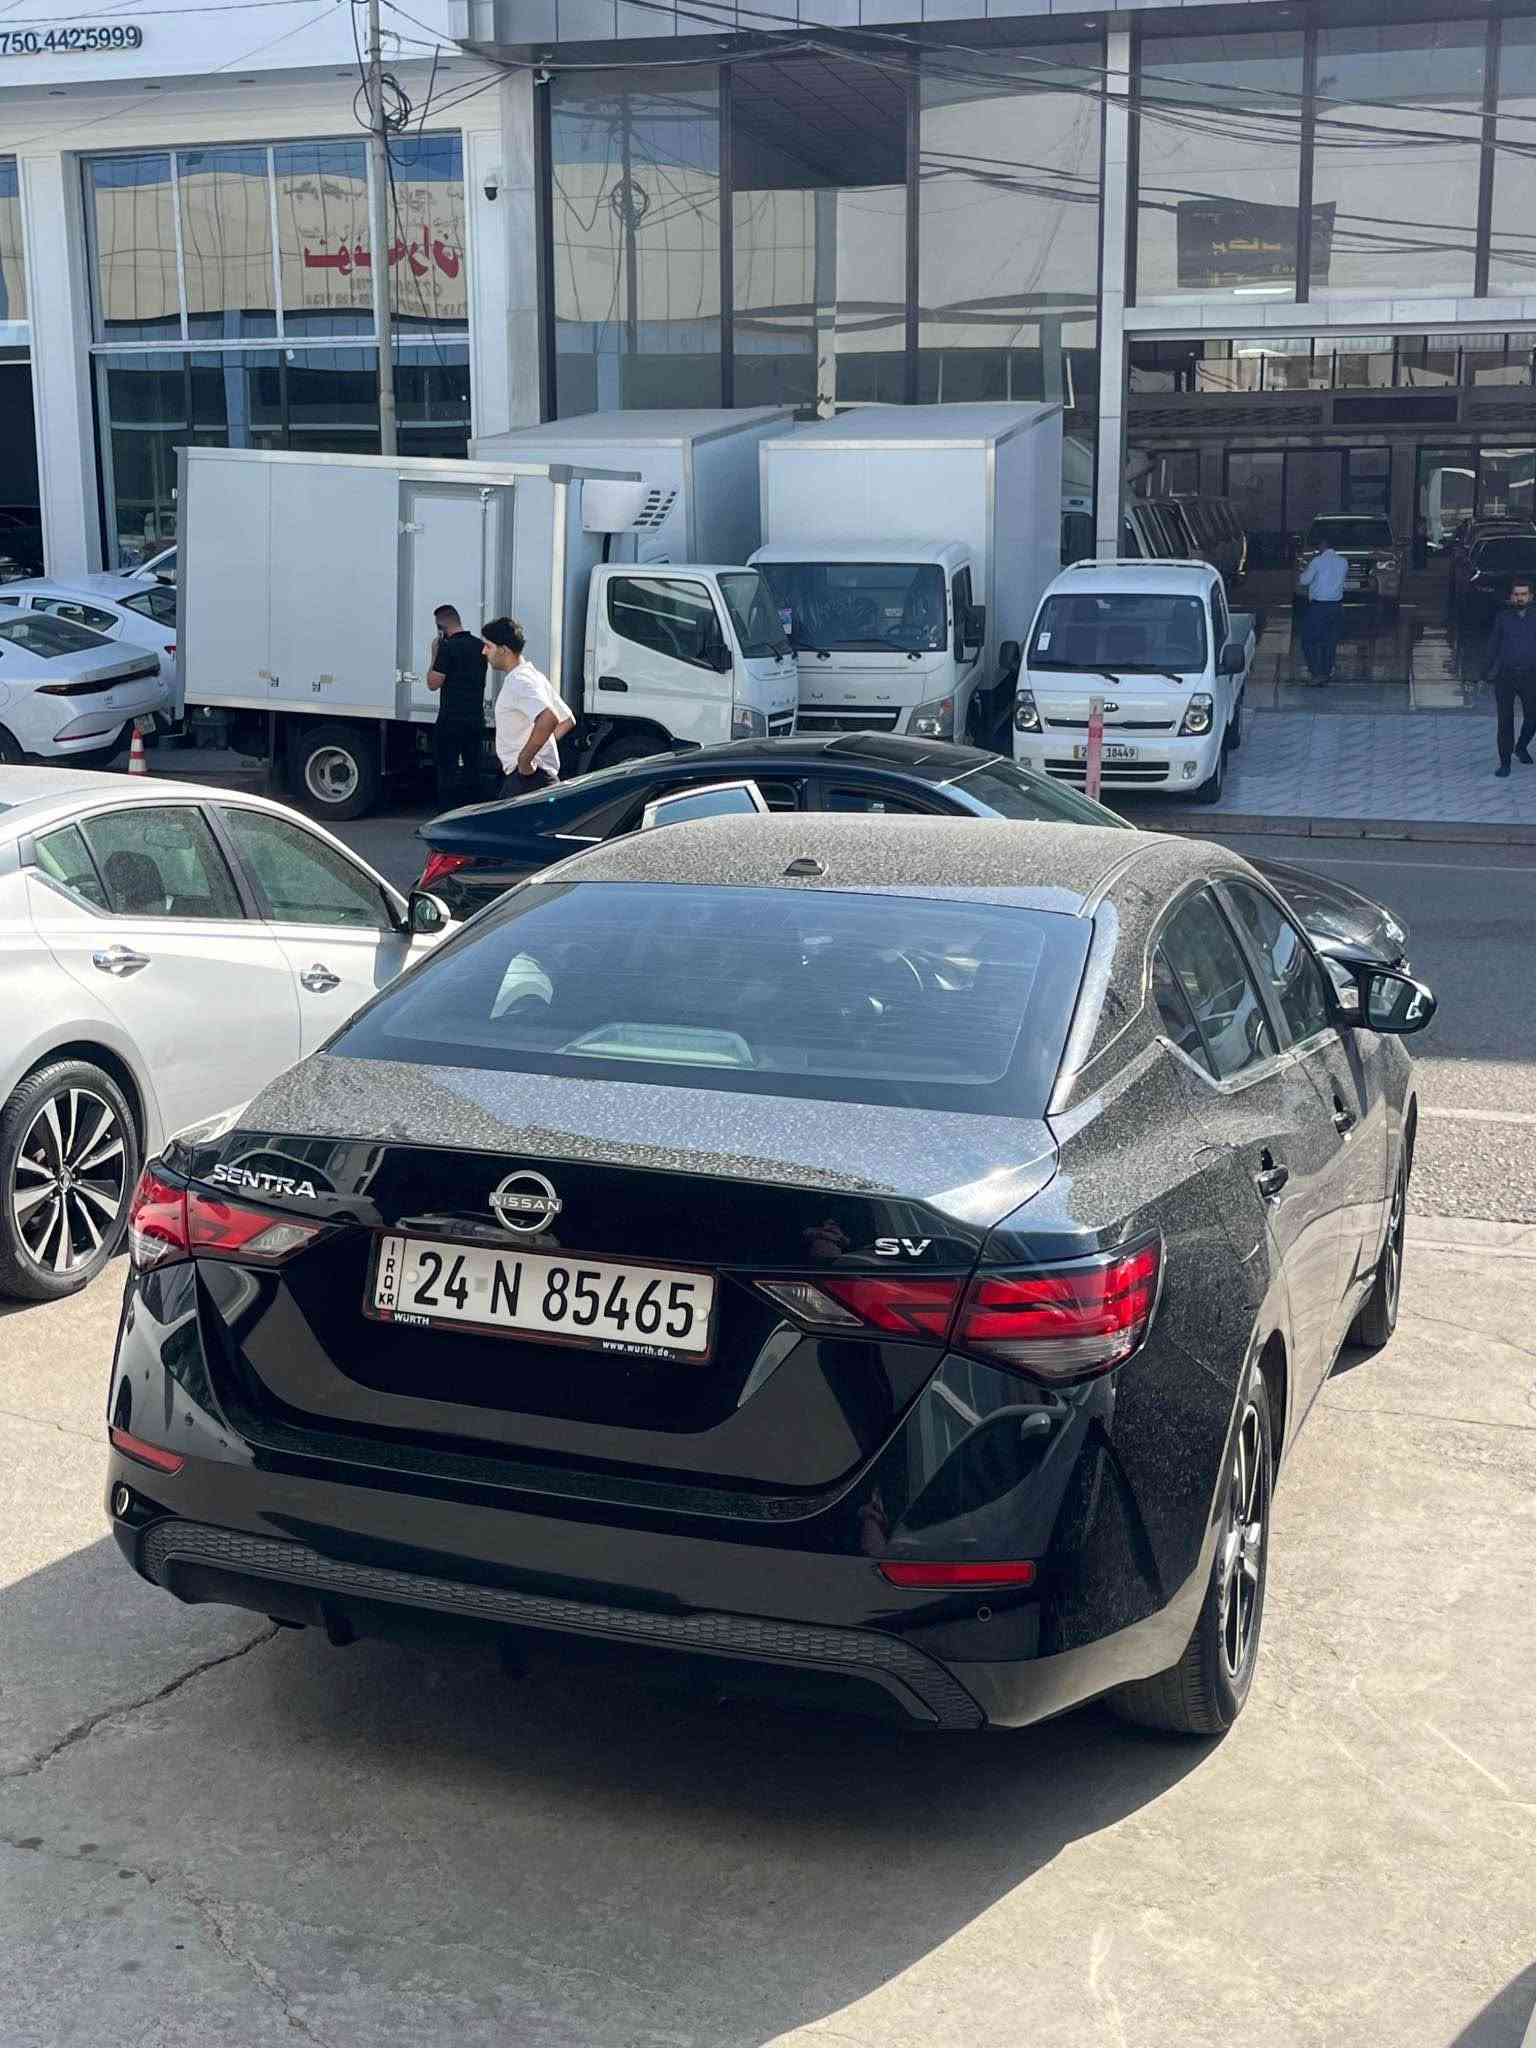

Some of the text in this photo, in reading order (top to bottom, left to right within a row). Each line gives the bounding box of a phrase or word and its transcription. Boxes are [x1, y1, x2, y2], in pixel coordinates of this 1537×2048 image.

[212, 1163, 317, 1199] SENTRA
[491, 1194, 560, 1211] NISSAN
[874, 1238, 932, 1256] SV
[378, 1292, 395, 1306] KR
[413, 1251, 695, 1338] 24 N 85465
